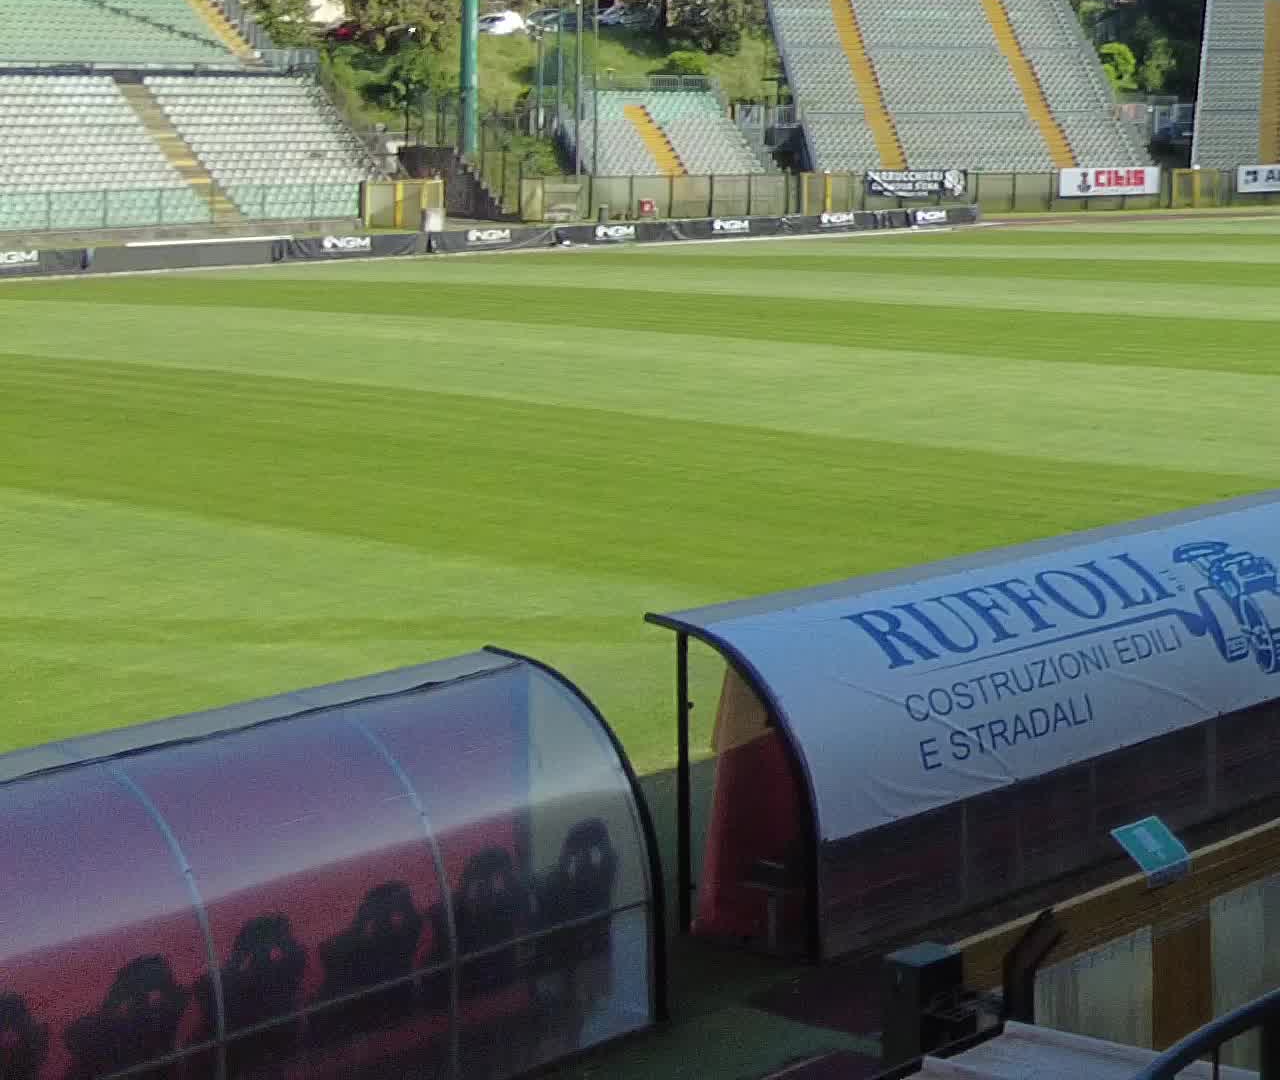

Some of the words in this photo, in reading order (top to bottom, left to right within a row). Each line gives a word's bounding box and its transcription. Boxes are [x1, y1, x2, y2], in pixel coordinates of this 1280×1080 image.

[326, 236, 371, 248] NGM
[470, 229, 510, 241] NGM
[840, 553, 1176, 670] RUFFOLI
[905, 644, 1111, 721] COSTRUZIONI
[1117, 624, 1183, 665] EDILI
[919, 737, 943, 771] E
[951, 693, 1094, 761] STRADALI
